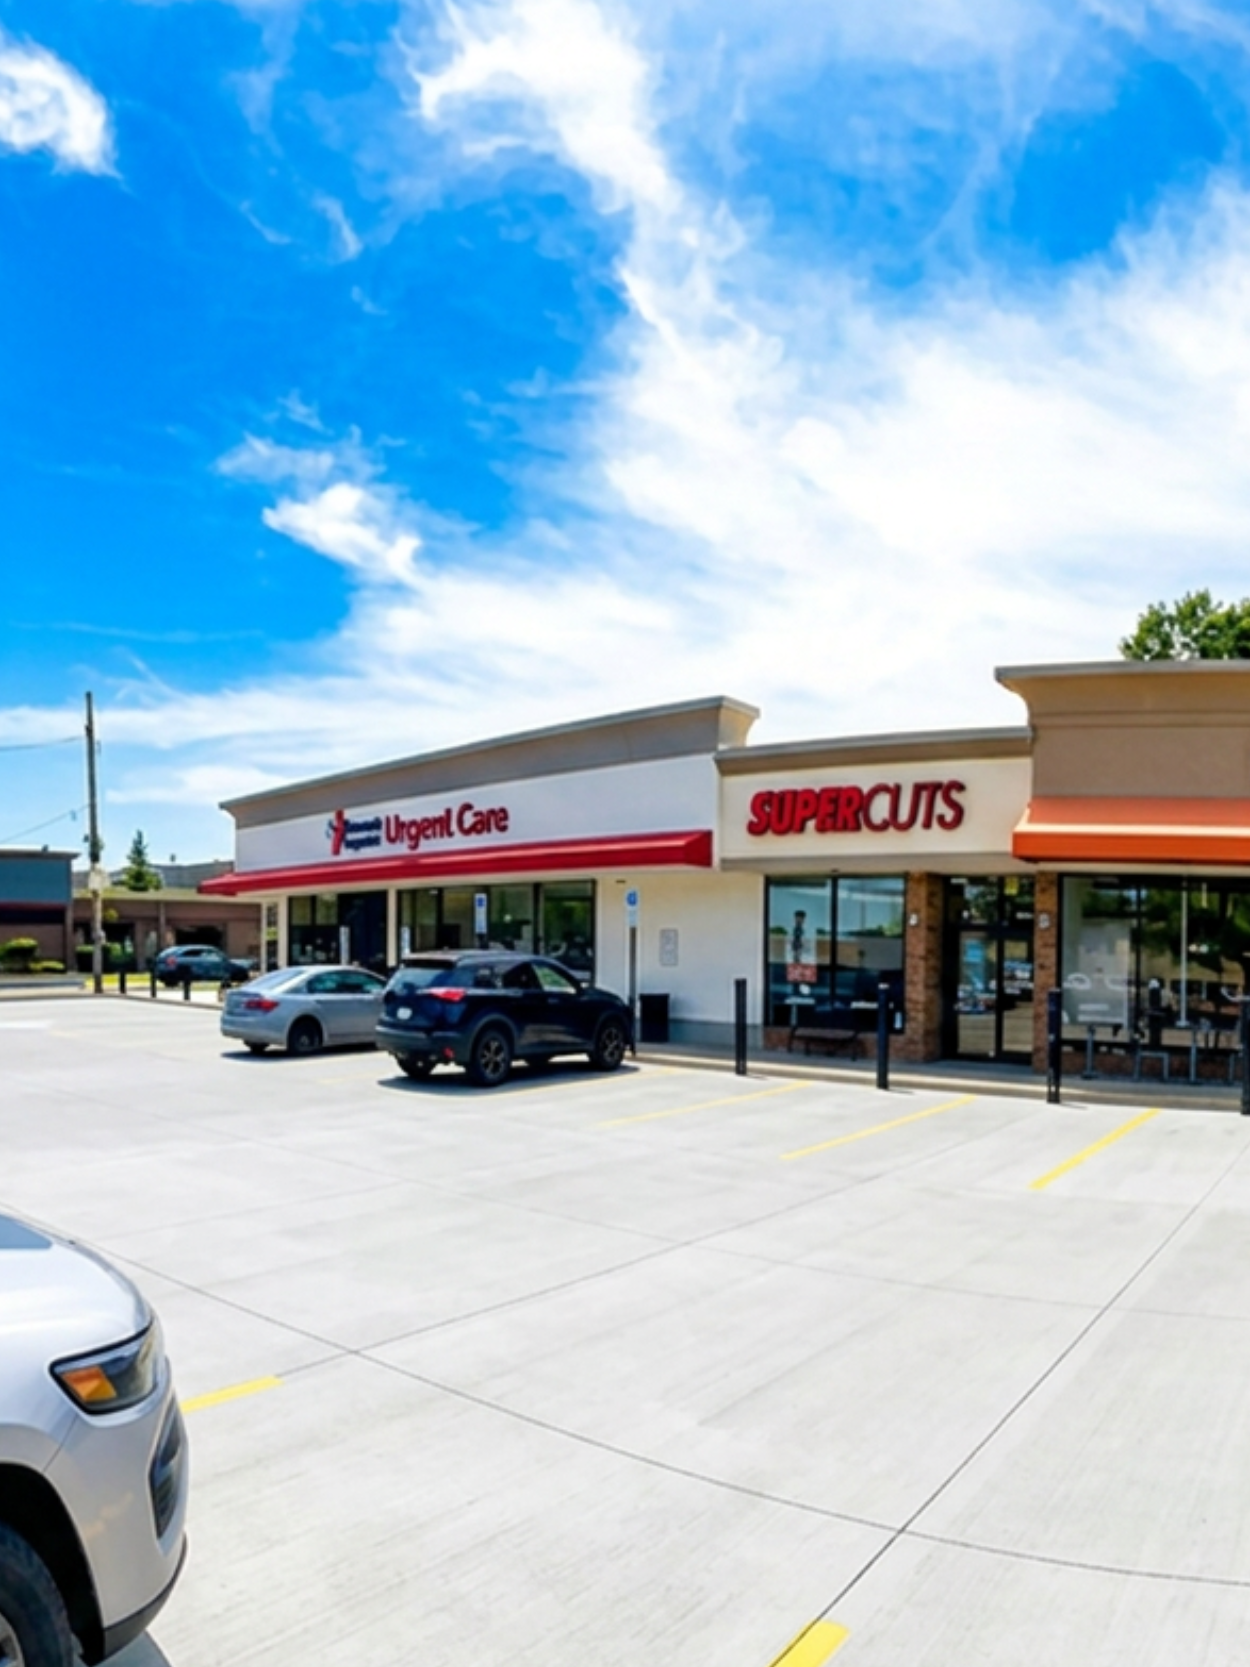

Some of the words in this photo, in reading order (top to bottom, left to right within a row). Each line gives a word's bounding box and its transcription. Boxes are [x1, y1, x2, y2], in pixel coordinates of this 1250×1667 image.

[386, 807, 454, 850] Urgent
[457, 802, 509, 836] Care
[747, 780, 966, 836] SUPERCUTS
